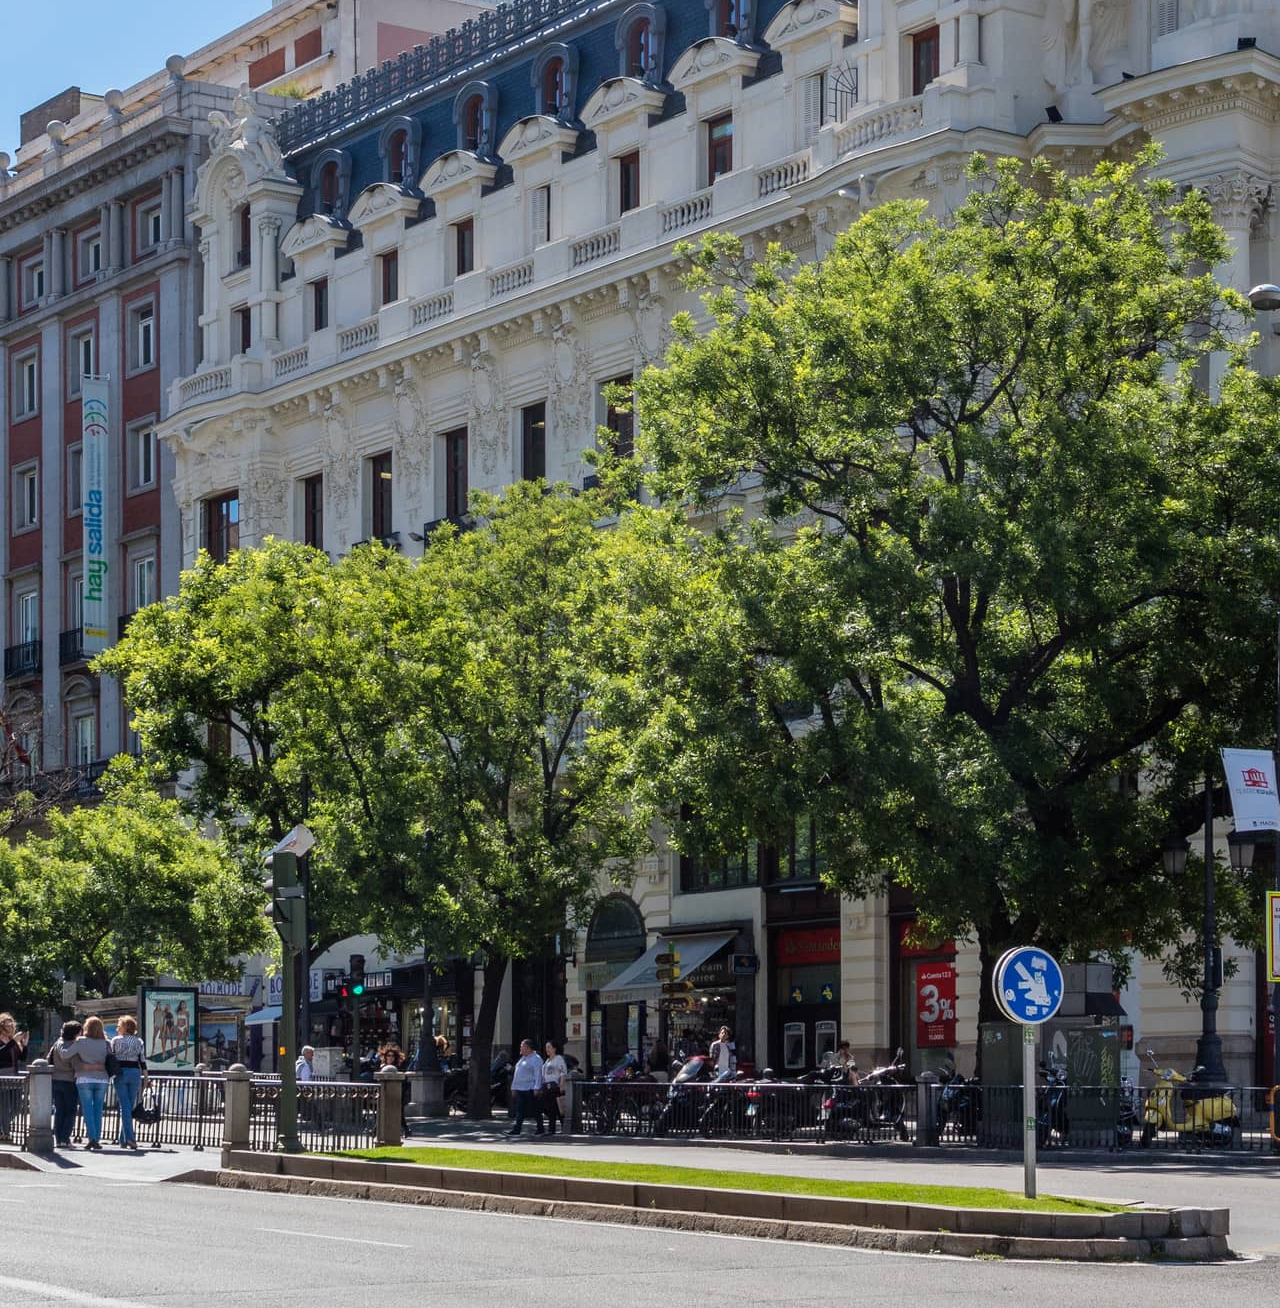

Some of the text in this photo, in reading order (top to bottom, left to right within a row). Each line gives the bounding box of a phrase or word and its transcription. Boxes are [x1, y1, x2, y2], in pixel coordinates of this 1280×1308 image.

[83, 490, 103, 556] salida
[83, 557, 108, 602] hay
[920, 984, 954, 1023] 3%
